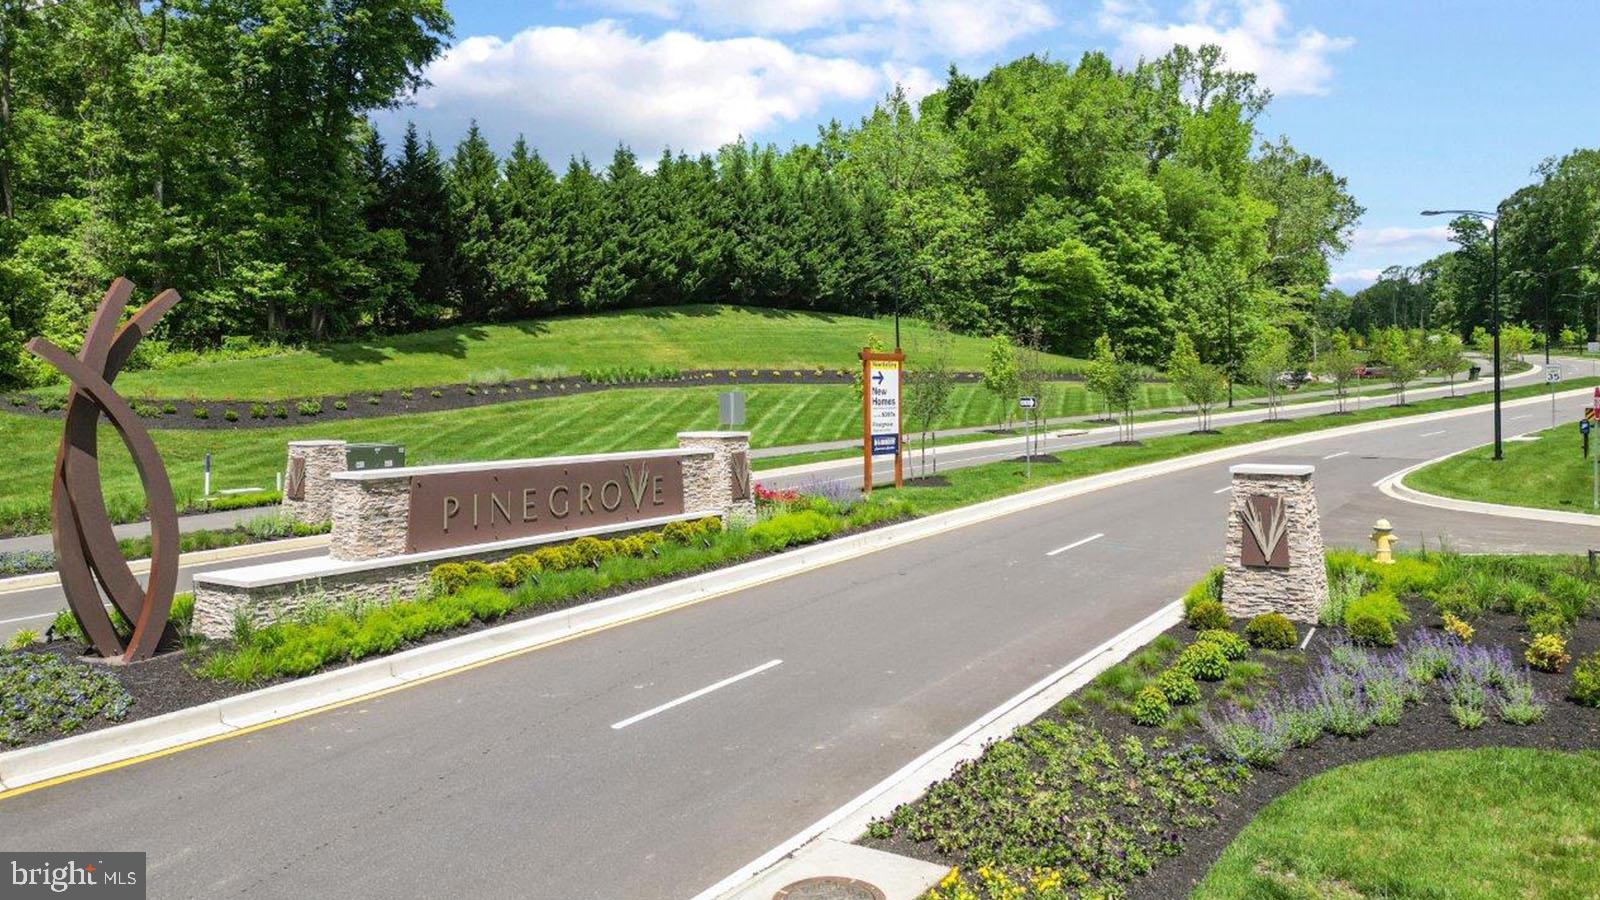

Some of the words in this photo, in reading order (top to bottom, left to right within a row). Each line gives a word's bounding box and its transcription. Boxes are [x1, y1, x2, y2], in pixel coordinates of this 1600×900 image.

[1547, 373, 1560, 381] 35
[872, 387, 887, 395] New
[872, 397, 896, 406] Homes
[442, 460, 665, 532] PINEGROVE
